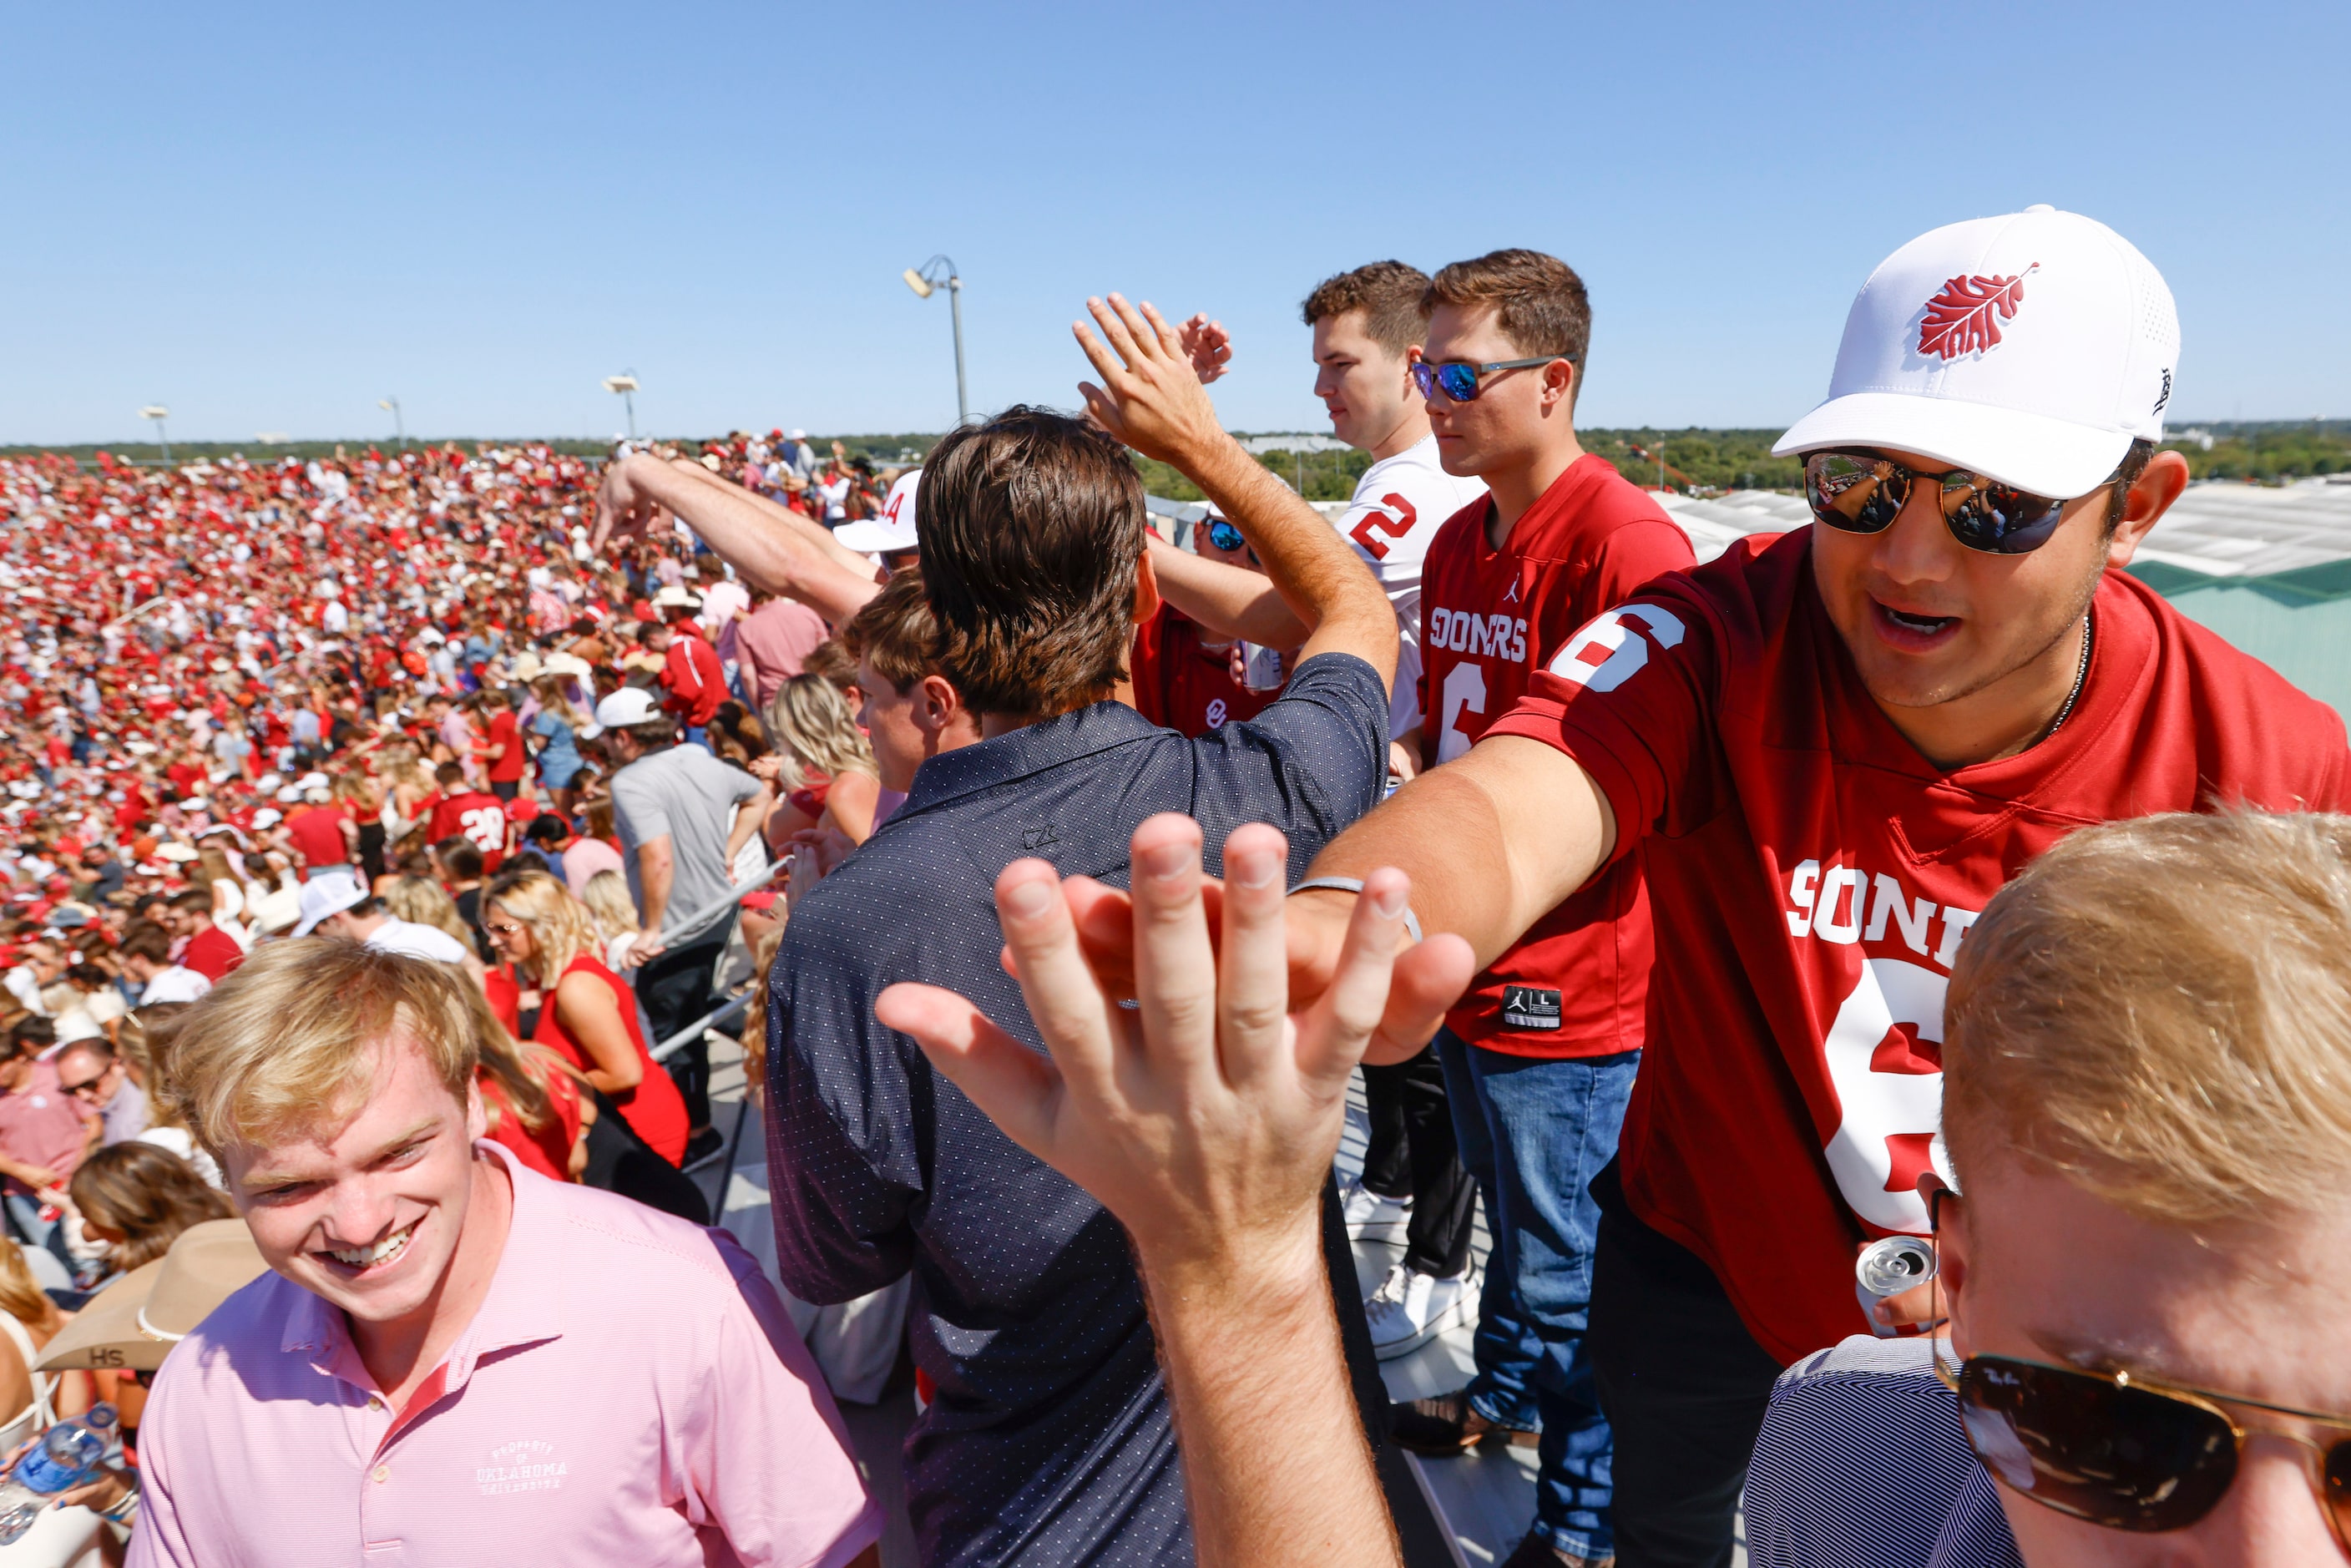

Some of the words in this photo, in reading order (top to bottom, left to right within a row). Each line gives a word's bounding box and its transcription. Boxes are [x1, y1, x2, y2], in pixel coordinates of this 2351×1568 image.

[1349, 493, 1417, 561] 2
[1549, 603, 1686, 694] 6
[1540, 994, 1550, 1004] L
[1824, 957, 1962, 1235] 6
[89, 1348, 125, 1368] HS
[492, 1439, 554, 1460] PROPERTY
[476, 1461, 568, 1483] OKLAHOMA
